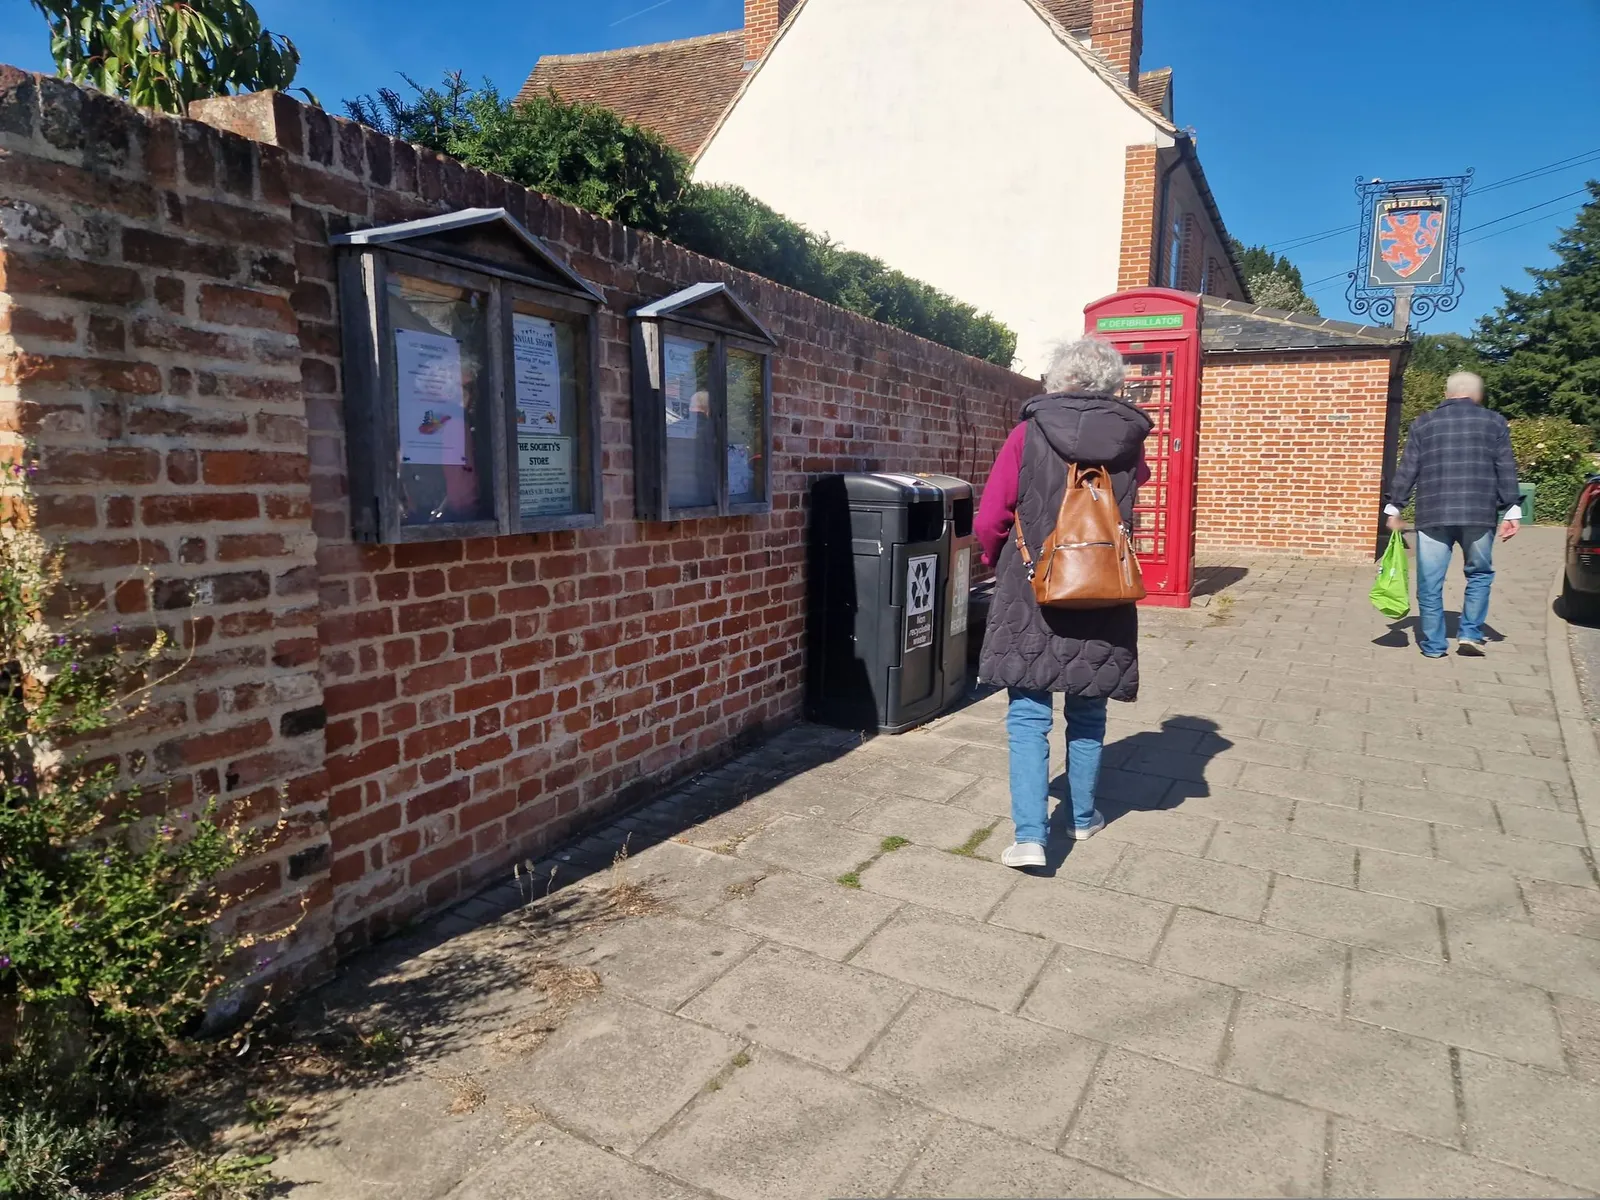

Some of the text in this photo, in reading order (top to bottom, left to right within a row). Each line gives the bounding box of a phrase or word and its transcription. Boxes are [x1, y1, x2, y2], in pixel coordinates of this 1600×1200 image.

[1384, 202, 1408, 210] RED
[1108, 316, 1181, 328] DEFIBRILLATOR
[514, 335, 535, 345] NNUAL
[530, 442, 560, 452] SOCIETY'S
[529, 457, 550, 465] STORE
